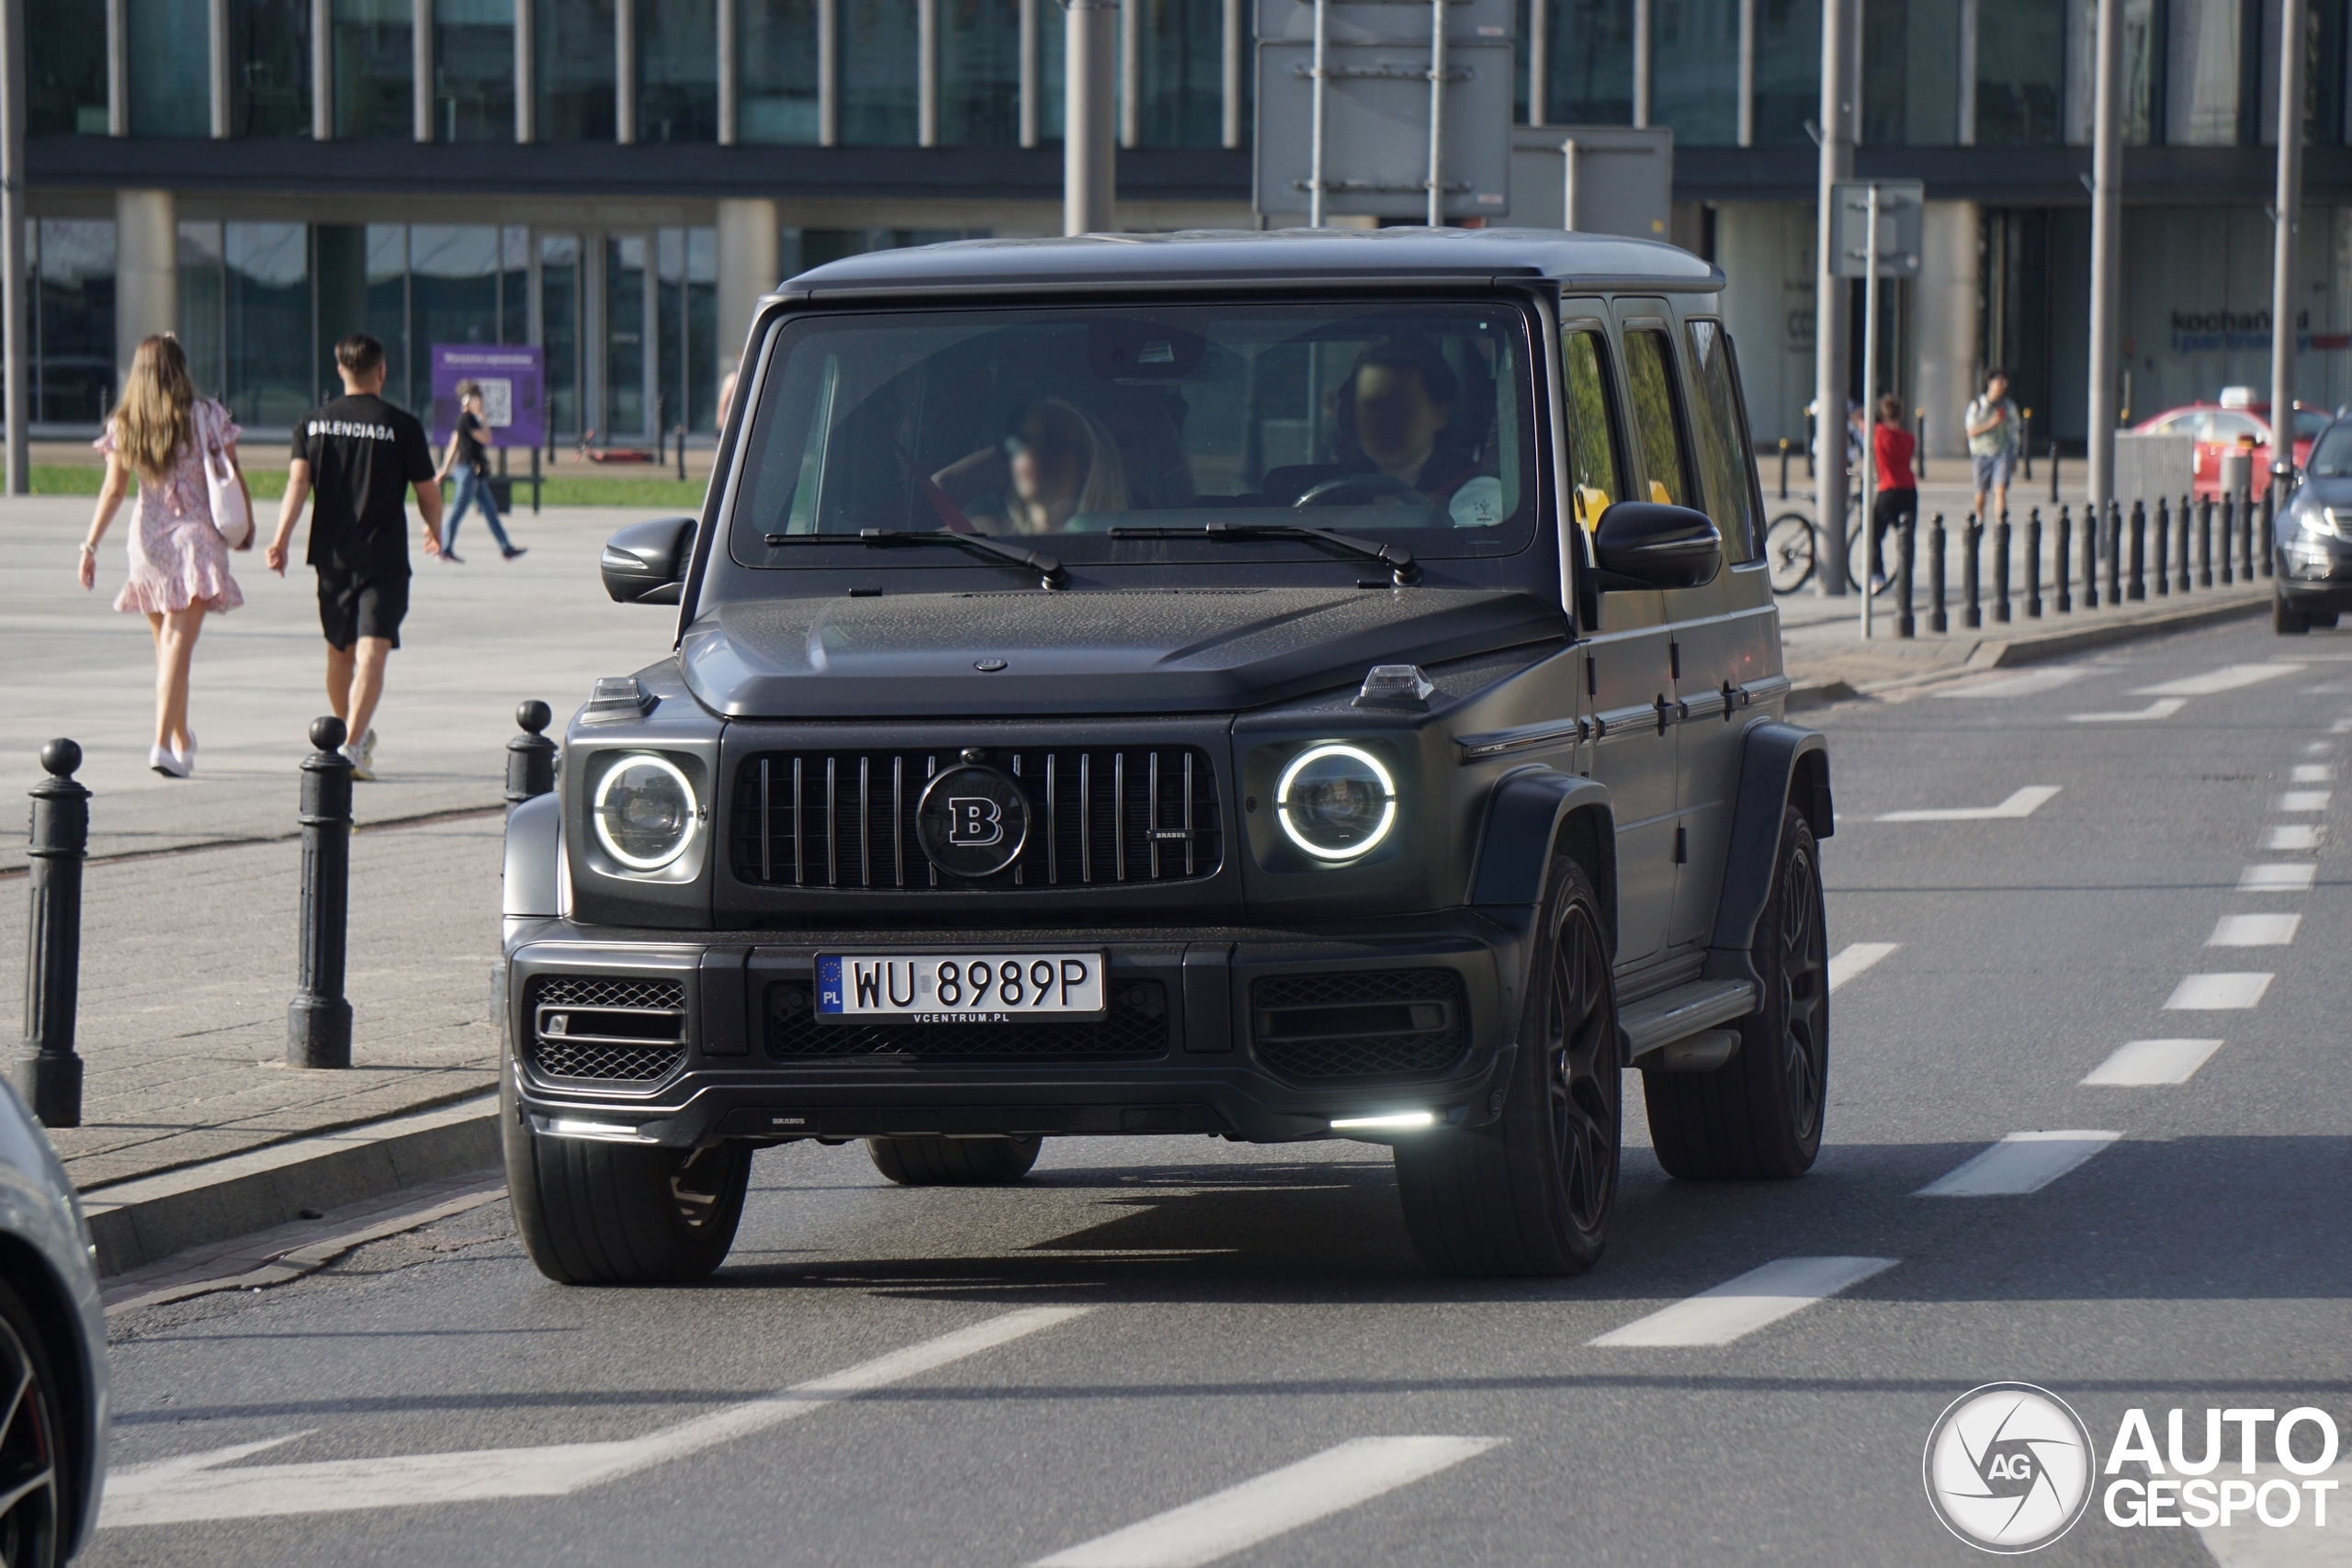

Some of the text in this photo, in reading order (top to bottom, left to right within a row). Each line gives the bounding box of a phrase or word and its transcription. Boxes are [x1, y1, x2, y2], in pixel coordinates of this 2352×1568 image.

[308, 420, 395, 442] BALENCIAGA
[949, 796, 1004, 846] B
[853, 959, 1088, 1008] WU 8989P
[823, 991, 841, 1004] PL
[913, 1013, 1010, 1022] VCENTRUM.PL
